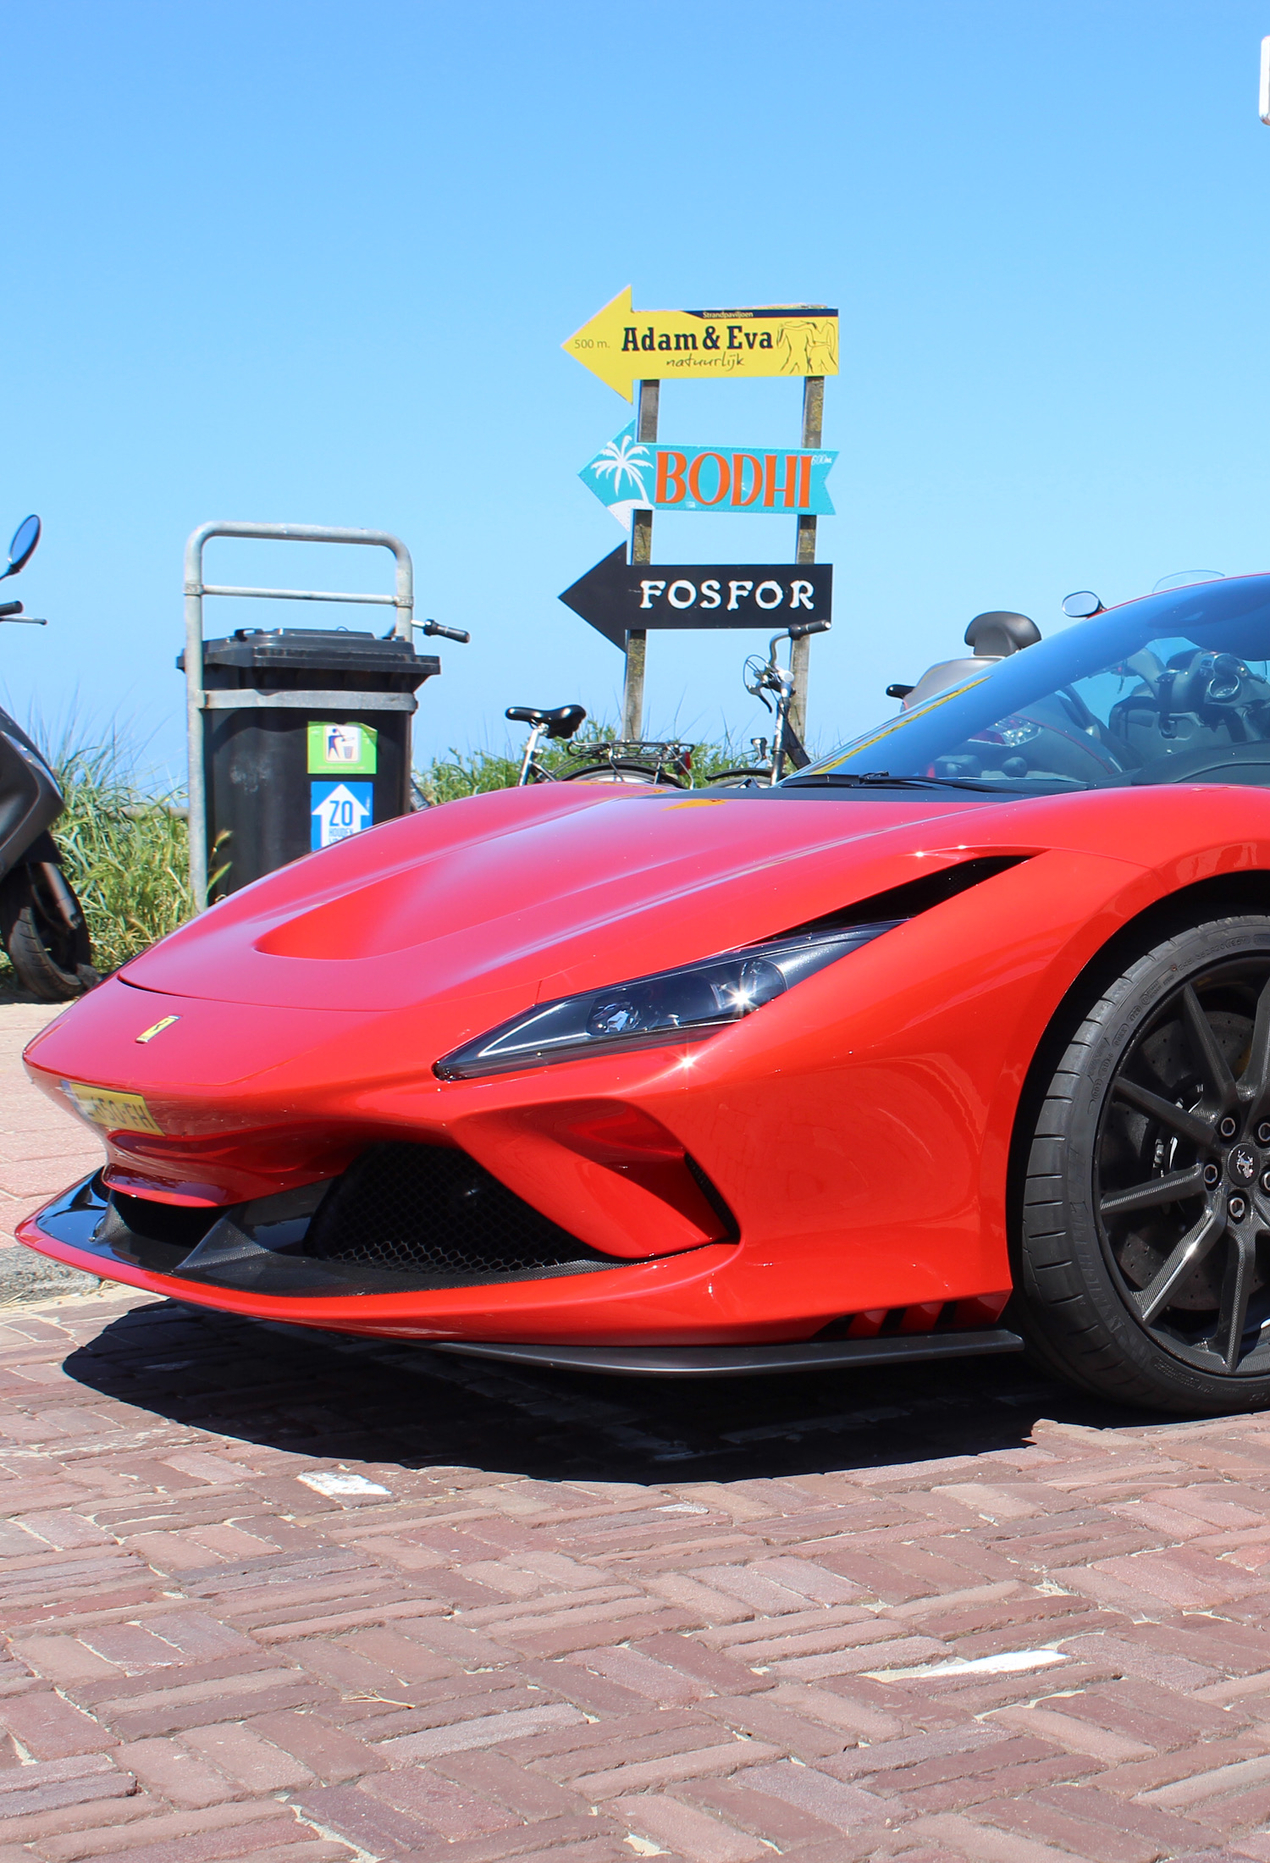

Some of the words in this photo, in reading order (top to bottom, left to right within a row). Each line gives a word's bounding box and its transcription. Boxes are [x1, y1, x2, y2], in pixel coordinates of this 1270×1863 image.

[574, 339, 594, 350] 500
[597, 340, 611, 349] m.
[621, 327, 698, 352] Adam
[702, 325, 721, 350] &
[726, 325, 774, 350] Eva
[666, 352, 745, 371] natuurlijk
[655, 451, 812, 508] BODHI
[639, 580, 815, 611] FOSFOR
[329, 800, 354, 827] ZO
